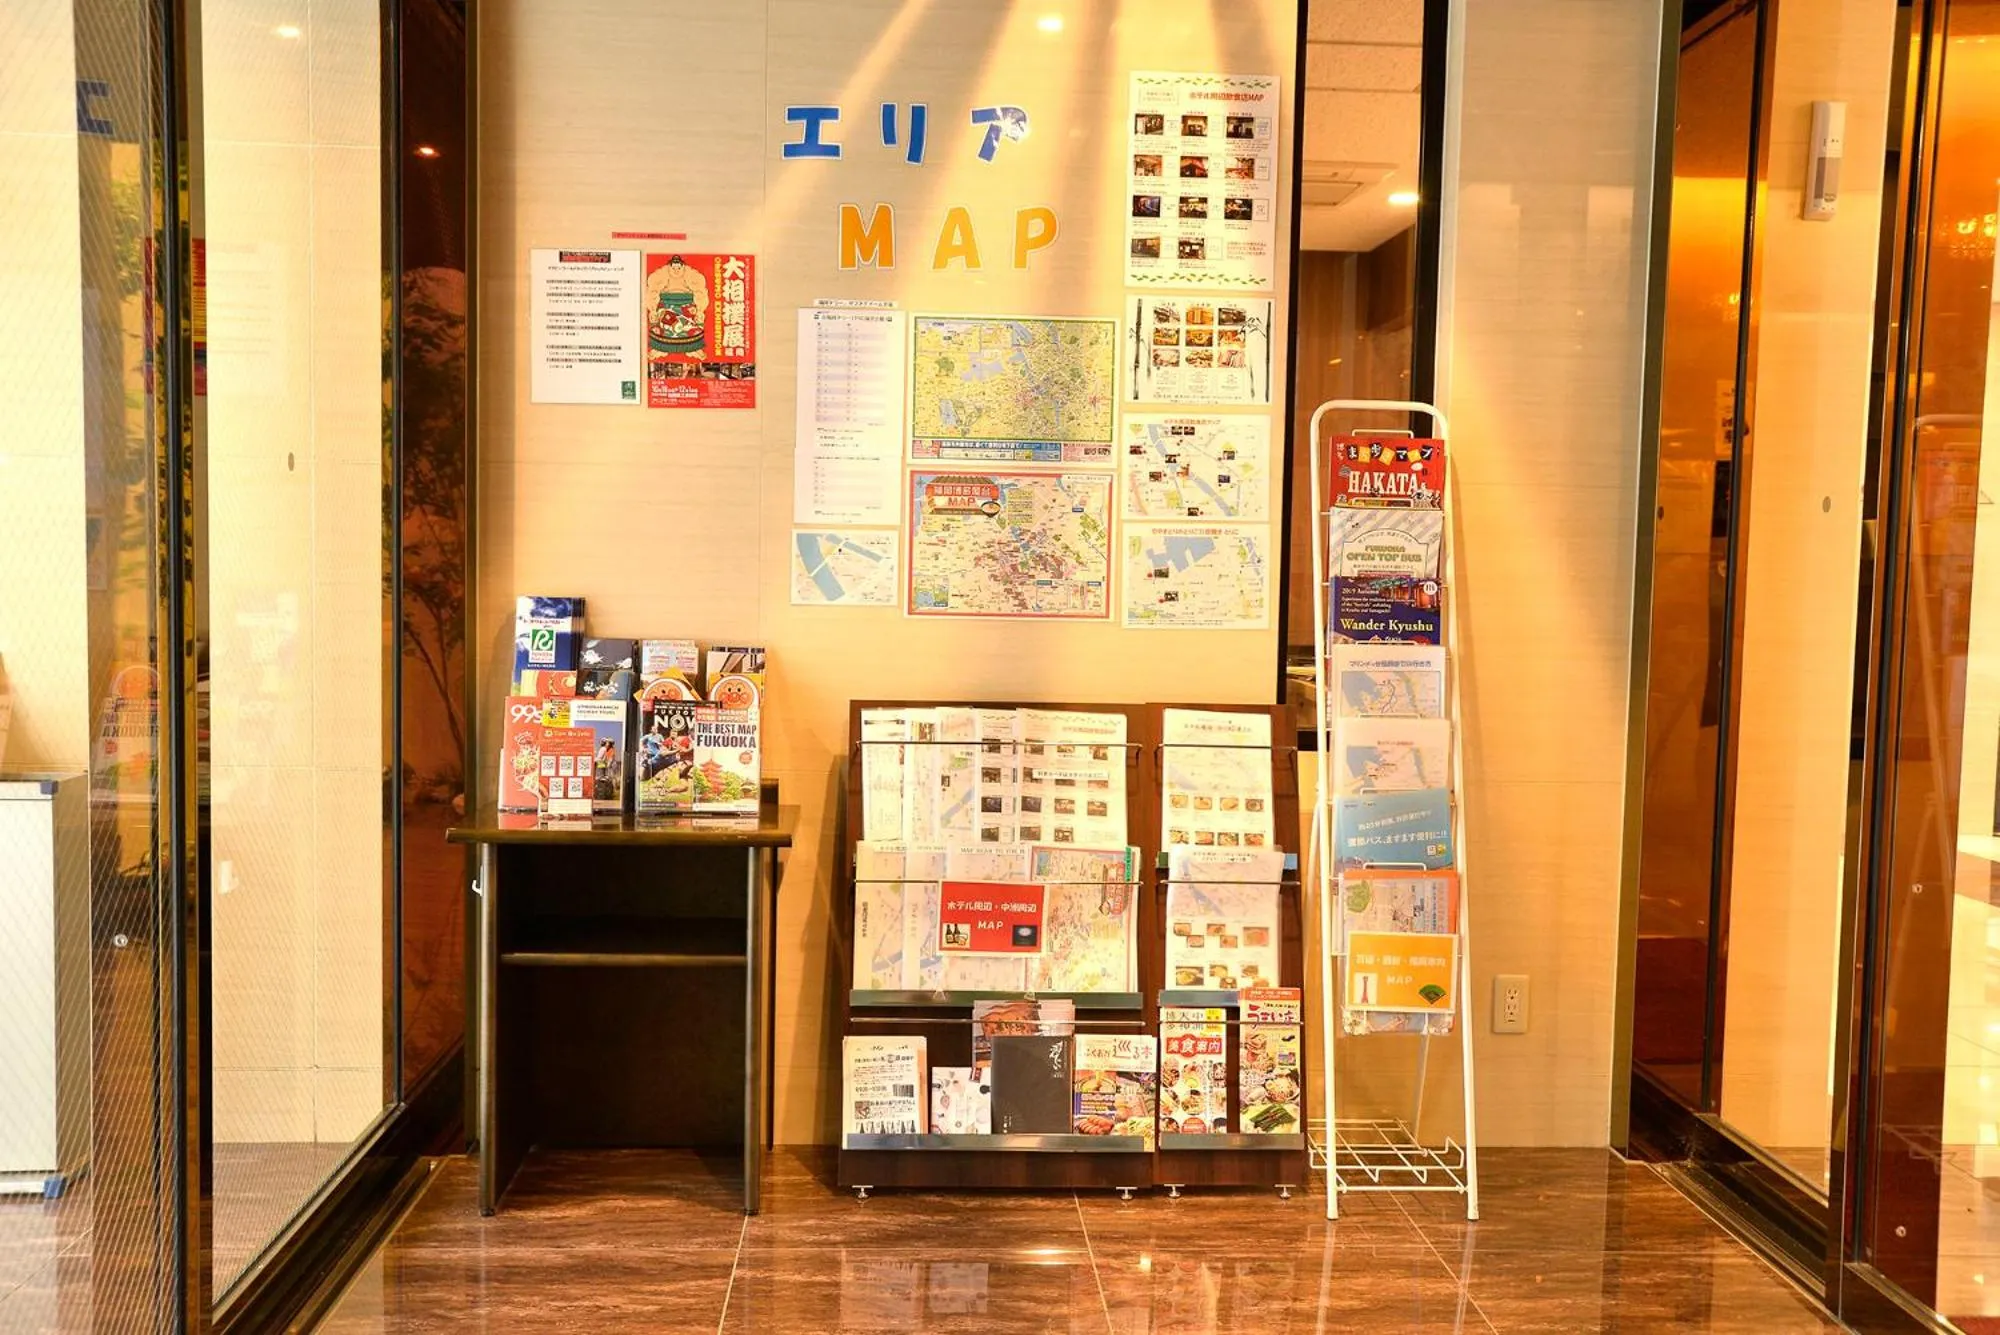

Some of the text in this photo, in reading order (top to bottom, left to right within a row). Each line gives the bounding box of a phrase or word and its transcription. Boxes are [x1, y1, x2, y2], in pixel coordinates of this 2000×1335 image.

[782, 103, 1027, 164] エリア
[839, 203, 1058, 270] MAP
[722, 256, 745, 348] 大相撲展
[1348, 471, 1418, 494] HAKATA
[947, 498, 976, 507] MAP
[1346, 552, 1422, 562] OPEN TOP BUS
[1340, 618, 1434, 633] Wander Kyushu
[697, 723, 757, 735] THE BEST MAP
[697, 735, 757, 748] FUKUOKA
[947, 901, 1037, 913] ホテル周辺・中洲周辺
[977, 921, 1004, 930] MAP
[1386, 975, 1413, 984] MAP
